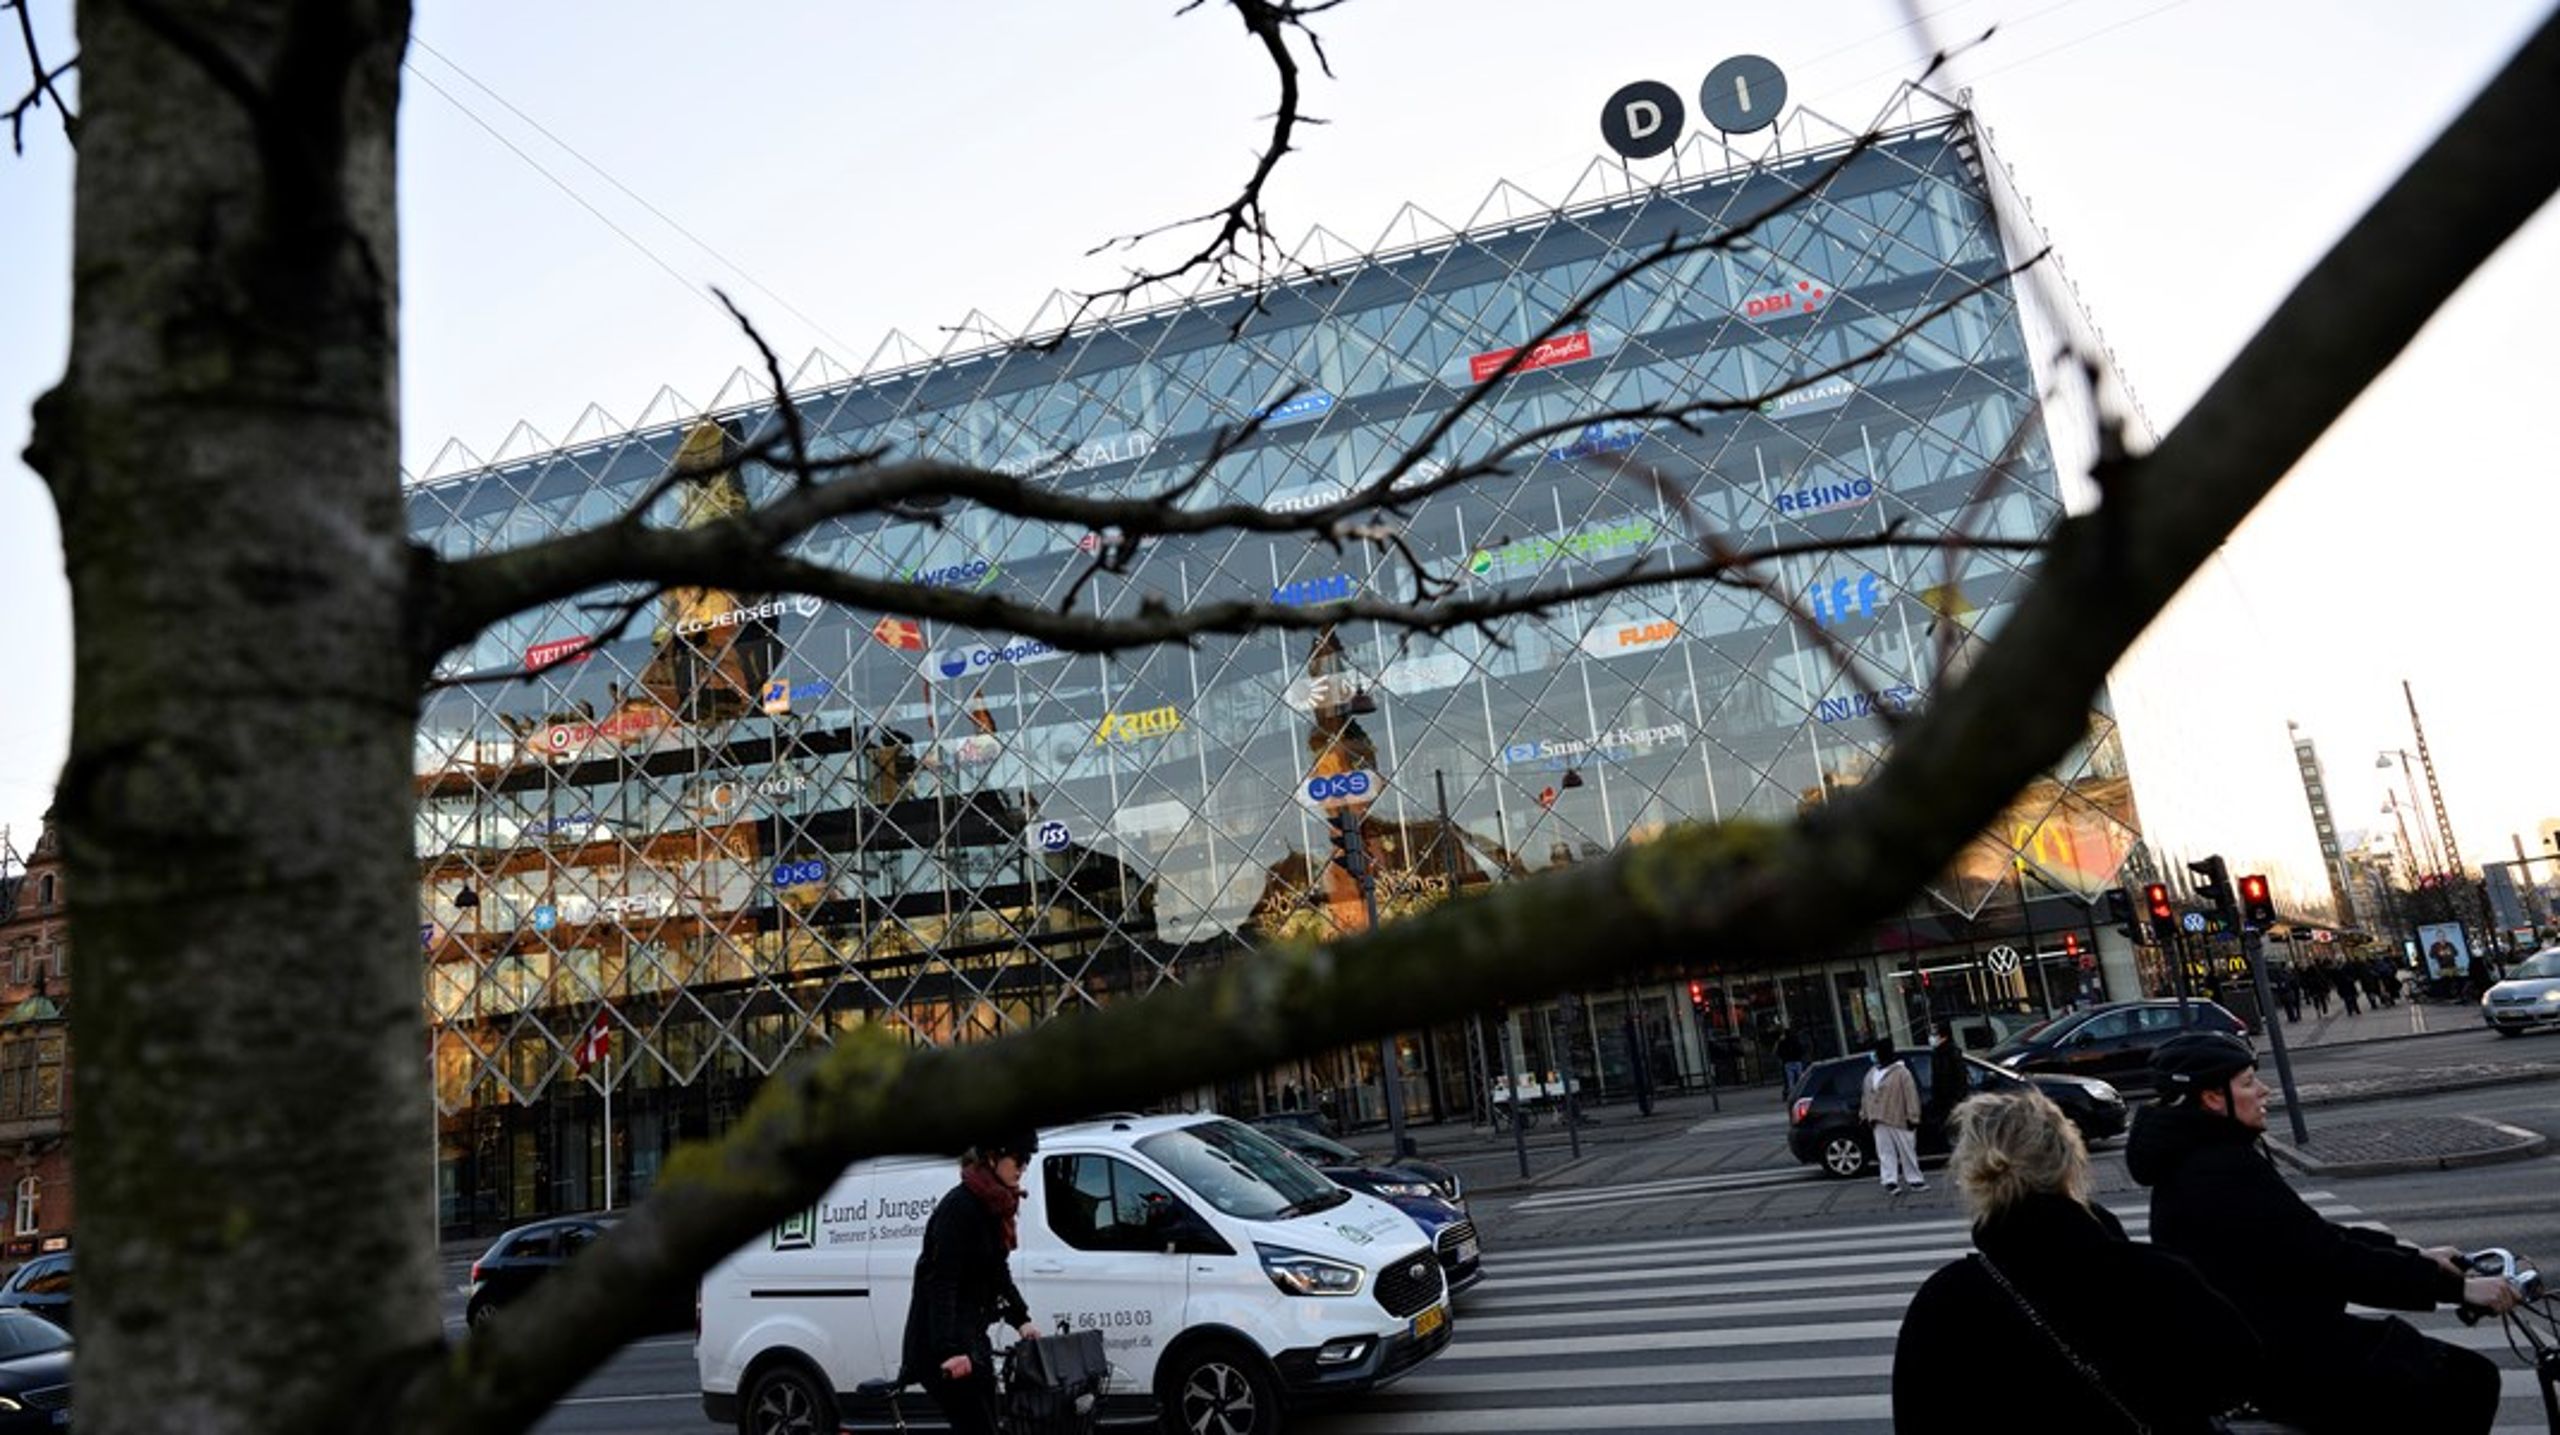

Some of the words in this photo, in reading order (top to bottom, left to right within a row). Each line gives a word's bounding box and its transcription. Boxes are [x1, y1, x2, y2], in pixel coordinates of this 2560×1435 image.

[1625, 99, 1662, 139] D
[1735, 76, 1752, 113] I
[1747, 292, 1791, 317] DBI
[1777, 478, 1873, 513] RESINO
[1311, 774, 1368, 798] JKS
[776, 862, 823, 884] JKS
[822, 1201, 867, 1224] Lund
[1079, 1312, 1096, 1328] 66
[1114, 1310, 1132, 1326] 03
[1134, 1310, 1152, 1326] 03
